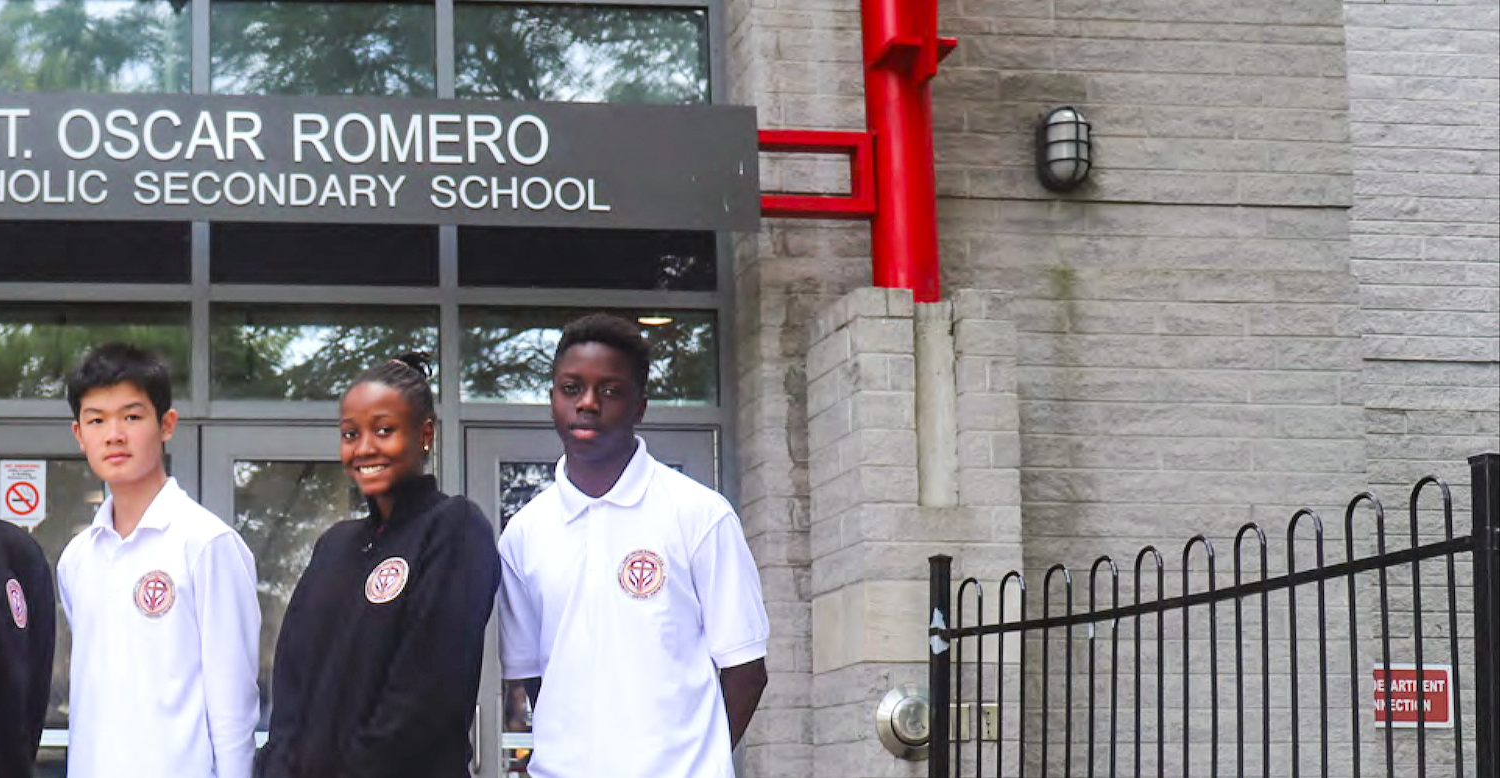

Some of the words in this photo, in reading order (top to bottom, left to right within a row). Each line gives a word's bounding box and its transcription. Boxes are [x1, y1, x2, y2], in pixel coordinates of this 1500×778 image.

[57, 107, 266, 161] OSCAR
[292, 112, 550, 165] ROMERO
[133, 170, 407, 207] SECONDARY
[430, 175, 612, 211] SCHOOL
